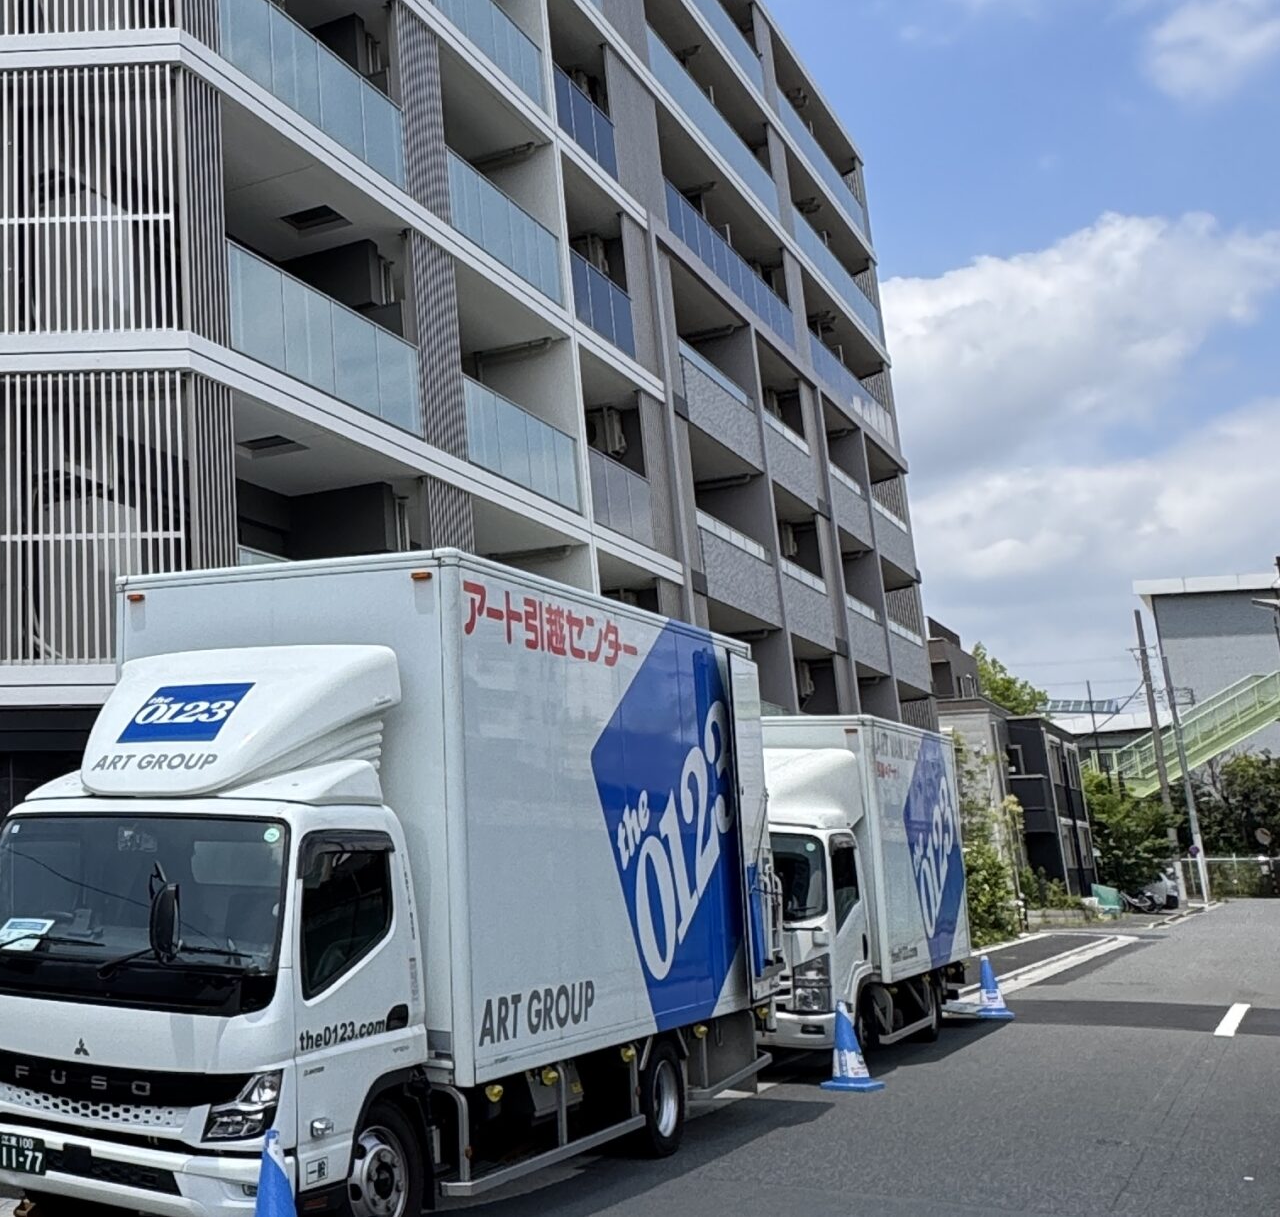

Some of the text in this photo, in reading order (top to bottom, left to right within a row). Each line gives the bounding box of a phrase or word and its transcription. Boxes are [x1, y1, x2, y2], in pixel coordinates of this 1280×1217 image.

[462, 579, 638, 667] アート引越センター
[134, 700, 236, 725] 0123
[91, 752, 218, 771] ART GROUP
[617, 789, 651, 871] the
[635, 700, 735, 981] 0123
[920, 775, 954, 939] 0123
[478, 980, 596, 1047] ART GROUP
[299, 1019, 386, 1051] the0123.com
[15, 1064, 151, 1096] FUSO
[2, 1146, 43, 1172] 11-77
[19, 1137, 34, 1149] 100
